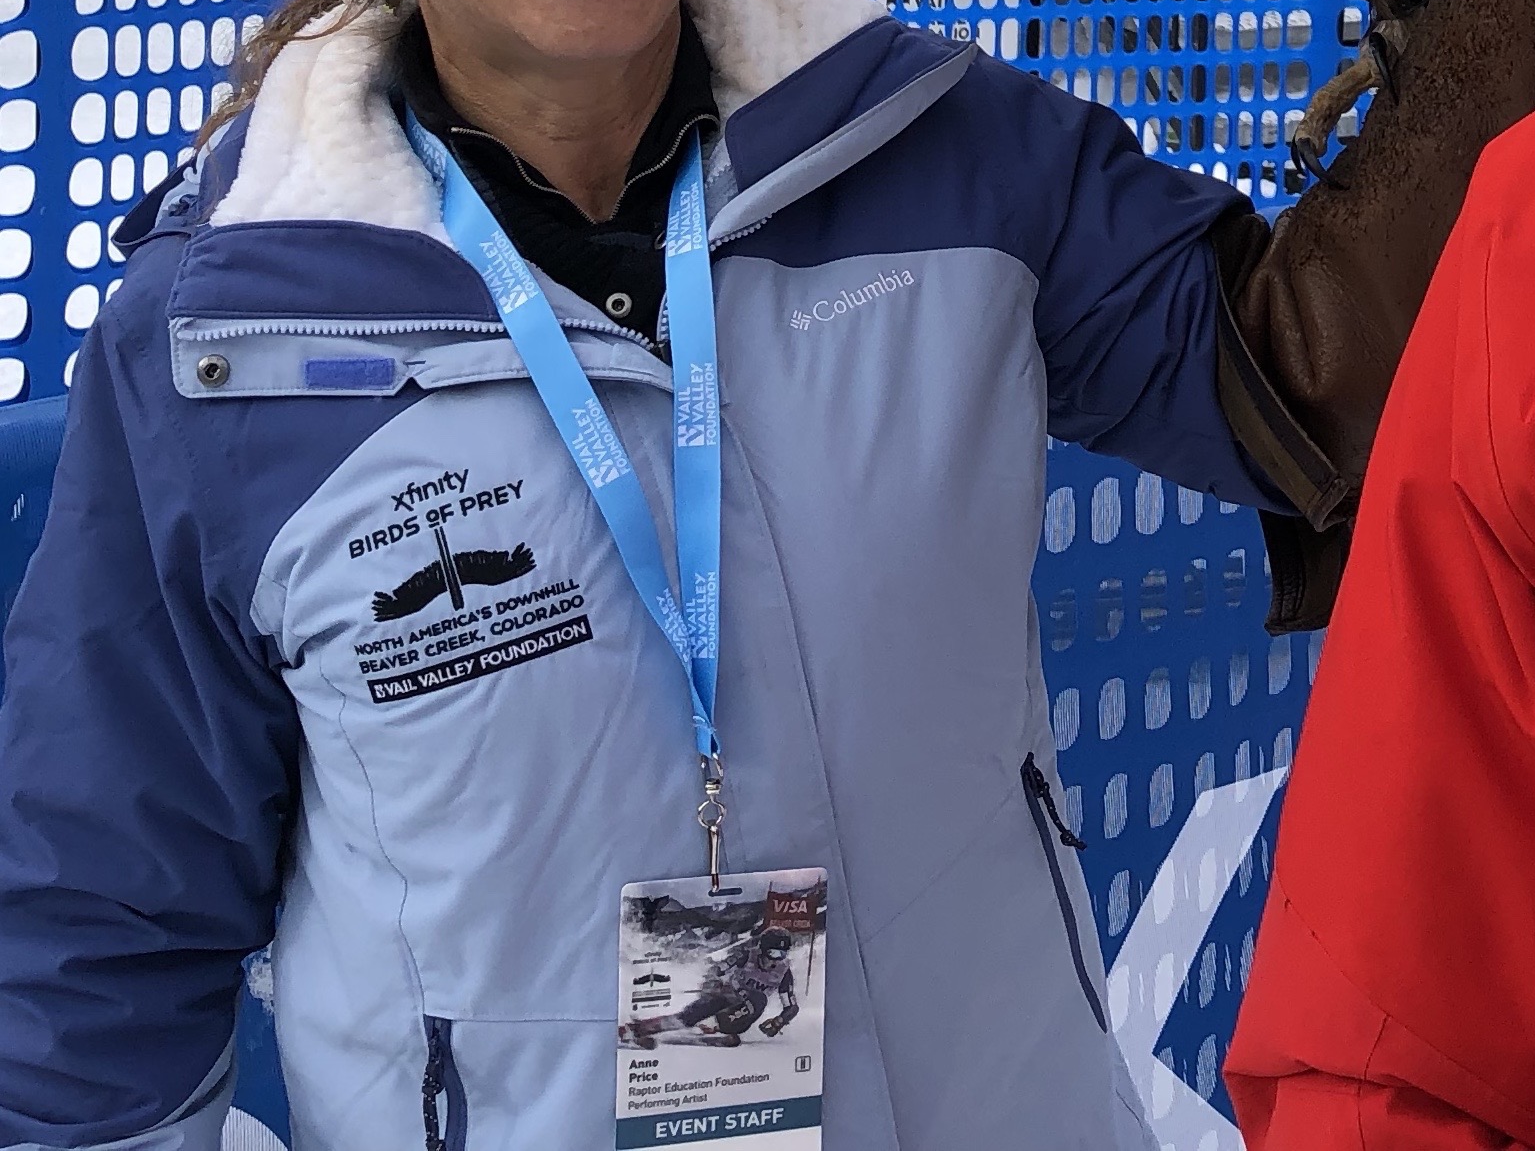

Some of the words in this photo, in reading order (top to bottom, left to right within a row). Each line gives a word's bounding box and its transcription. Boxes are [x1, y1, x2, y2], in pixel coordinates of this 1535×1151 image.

[666, 210, 681, 241] VAIL
[680, 190, 691, 236] VALLEY
[691, 181, 703, 249] FOUNDATION
[479, 241, 516, 288] VALLEY
[482, 264, 505, 297] VAIL
[490, 230, 540, 298] FOUNDATION
[812, 269, 915, 322] Columbia
[678, 386, 691, 423] VAIL
[690, 363, 705, 423] VALLEY
[704, 362, 717, 446] FOUNDATION
[571, 433, 594, 468] VAIL
[572, 408, 608, 462] VALLEY
[584, 397, 631, 475] FOUNDATION
[390, 468, 469, 512] xfinity
[348, 514, 421, 559] BIRDS
[425, 508, 455, 528] OF
[459, 479, 524, 517] PREY
[354, 635, 404, 657] NORTH
[408, 605, 493, 646] AMERICA'S
[496, 579, 580, 616] DOWNHILL
[685, 598, 697, 635] VAIL
[694, 572, 708, 635] VALLEY
[707, 571, 716, 659] FOUNDATION
[358, 651, 420, 674] BEAVER
[424, 629, 486, 657] CREEK,
[489, 594, 585, 635] COLORADO
[384, 677, 417, 697] VAIL
[418, 659, 475, 688] VALLEY
[480, 624, 588, 669] FOUNDATION
[773, 899, 808, 914] VISA
[628, 1072, 659, 1084] Price
[628, 1085, 662, 1098] Raptor
[664, 1079, 713, 1094] Education
[715, 1073, 770, 1088] Foundation
[629, 1058, 660, 1070] Anne
[627, 1097, 681, 1111] Performing
[682, 1093, 708, 1105] Artist
[655, 1115, 720, 1139] EVENT
[724, 1107, 785, 1131] STAFF
